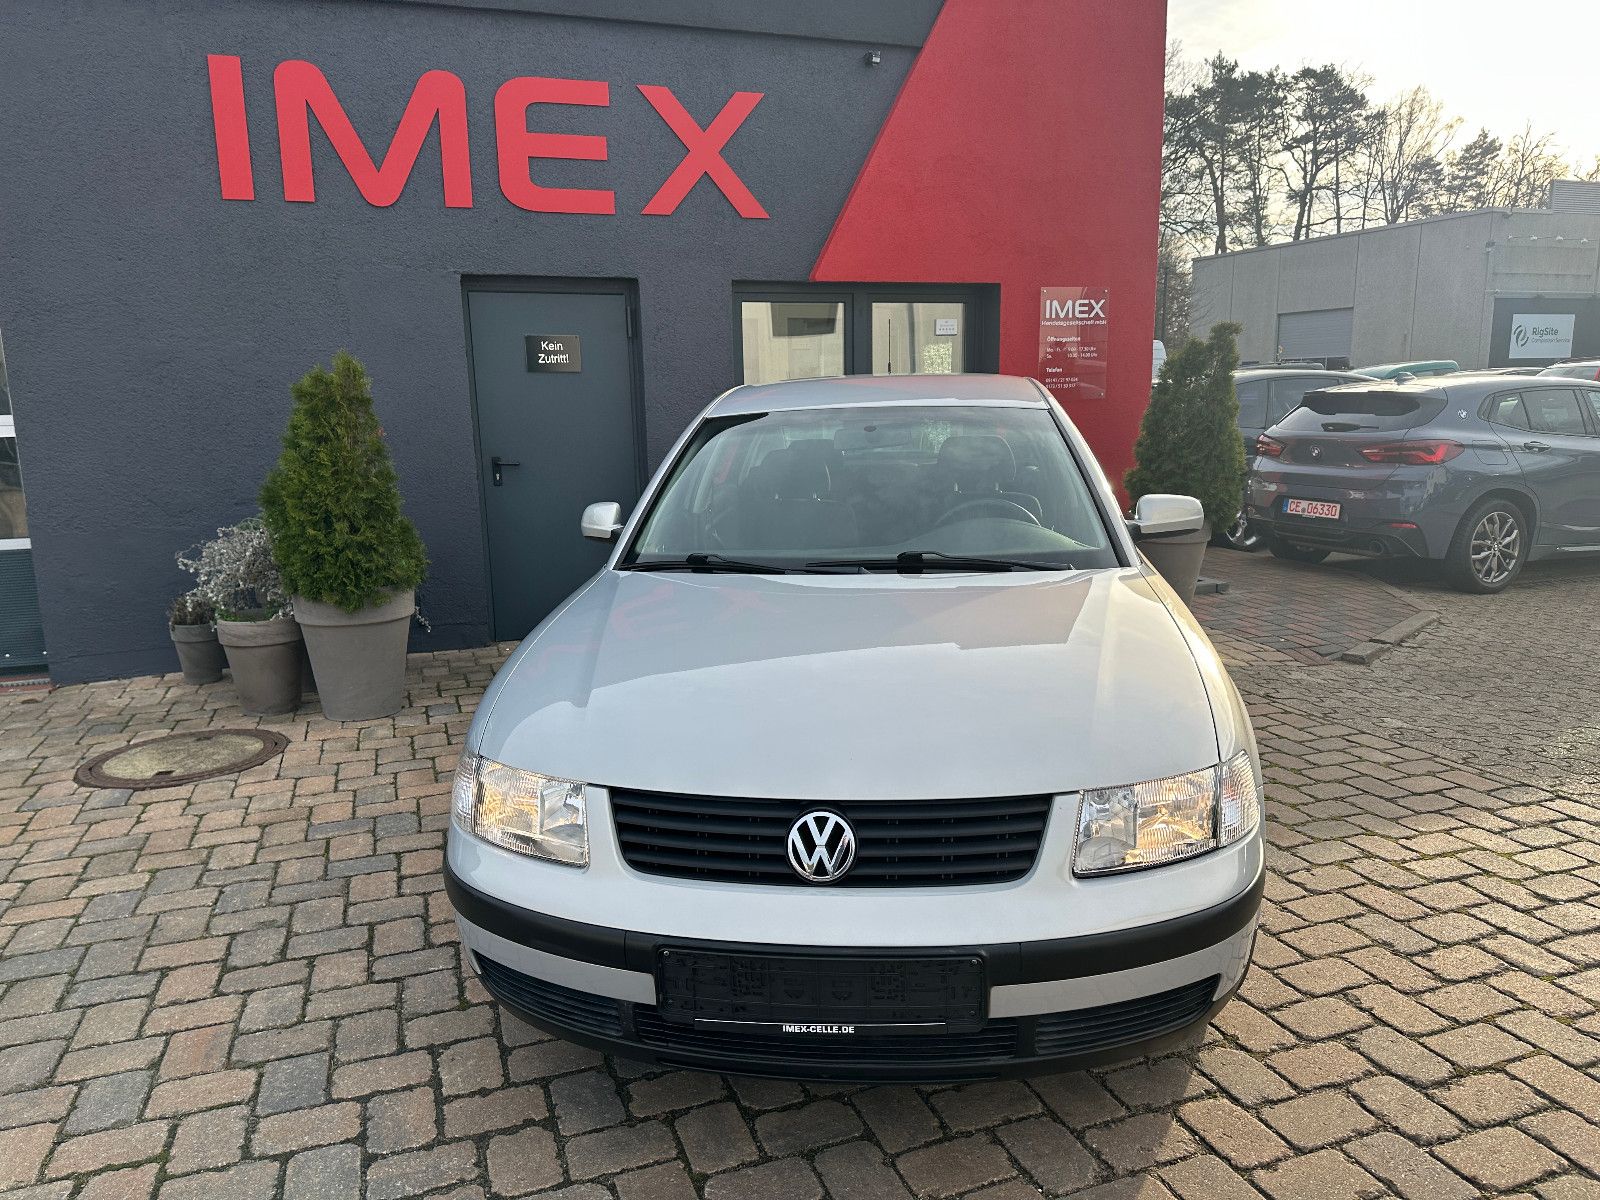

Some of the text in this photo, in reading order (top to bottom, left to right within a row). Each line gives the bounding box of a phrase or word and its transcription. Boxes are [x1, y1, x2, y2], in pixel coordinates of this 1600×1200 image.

[207, 54, 771, 219] IMEX
[1045, 299, 1106, 318] IMEX
[1532, 327, 1559, 338] RigSite
[540, 341, 564, 351] Kein
[538, 354, 570, 364] Zutritt!
[1289, 501, 1338, 517] CE 06330
[787, 811, 856, 881] VW
[782, 1024, 855, 1034] IMEX-CELLE.DE
